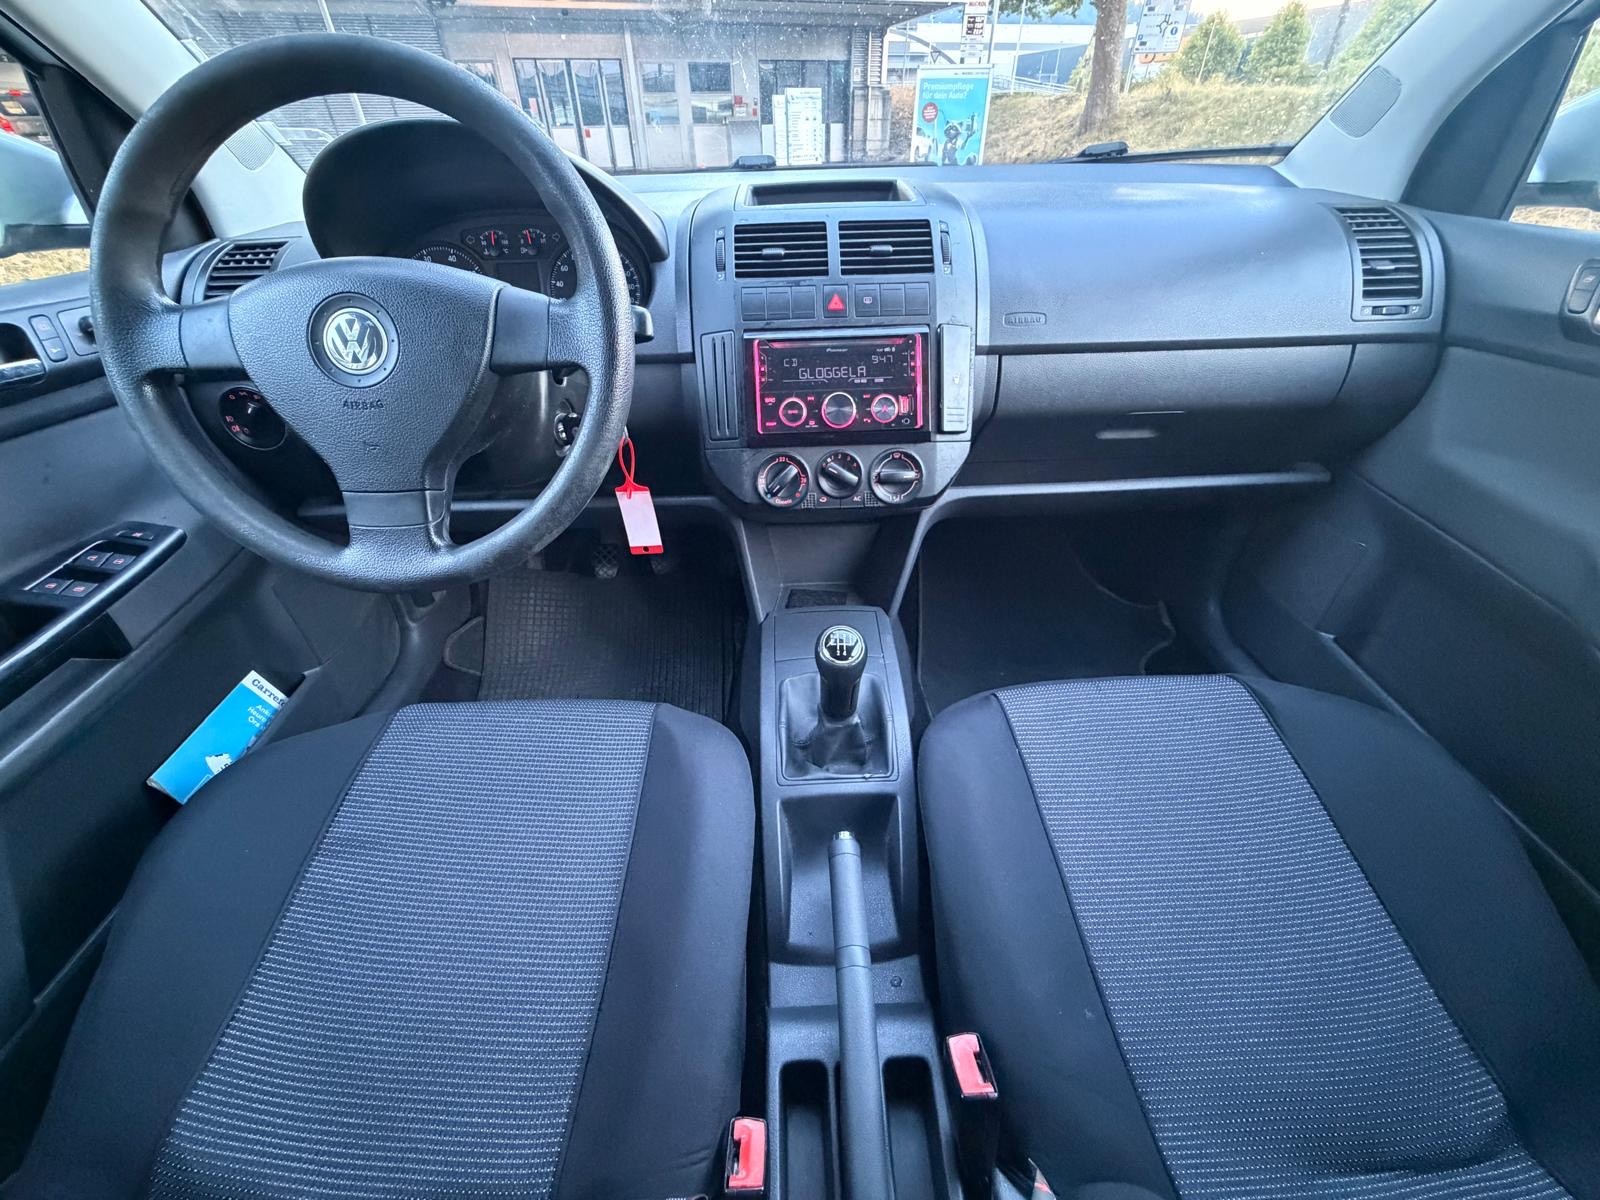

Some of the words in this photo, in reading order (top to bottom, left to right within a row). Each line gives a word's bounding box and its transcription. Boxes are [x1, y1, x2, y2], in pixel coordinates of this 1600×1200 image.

[448, 255, 457, 263] 40
[783, 358, 798, 367] CD
[342, 399, 385, 411] AIRBAG
